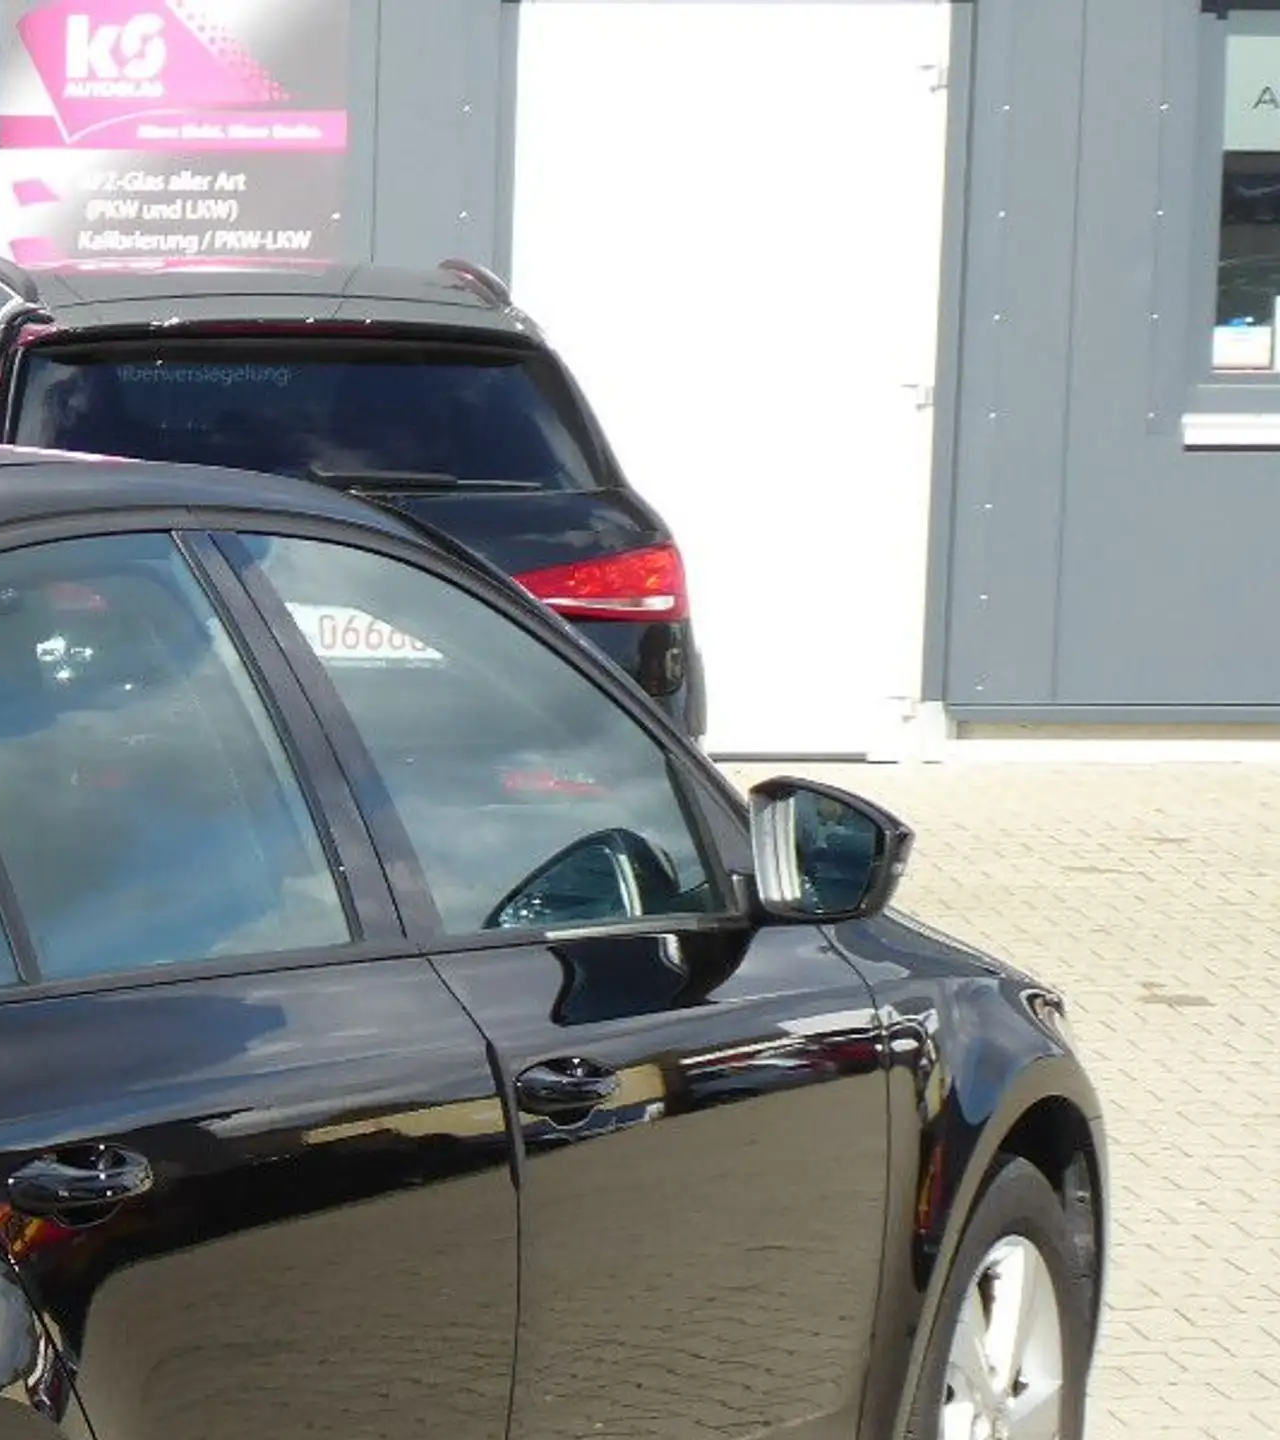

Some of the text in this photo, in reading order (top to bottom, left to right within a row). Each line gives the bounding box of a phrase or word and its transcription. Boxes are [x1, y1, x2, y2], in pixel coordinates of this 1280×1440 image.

[167, 171, 212, 191] aller
[214, 172, 247, 191] Art
[86, 198, 238, 222] (PKW und LKW)
[77, 229, 199, 253] Kalibrierung
[214, 229, 312, 250] PKW-LKW
